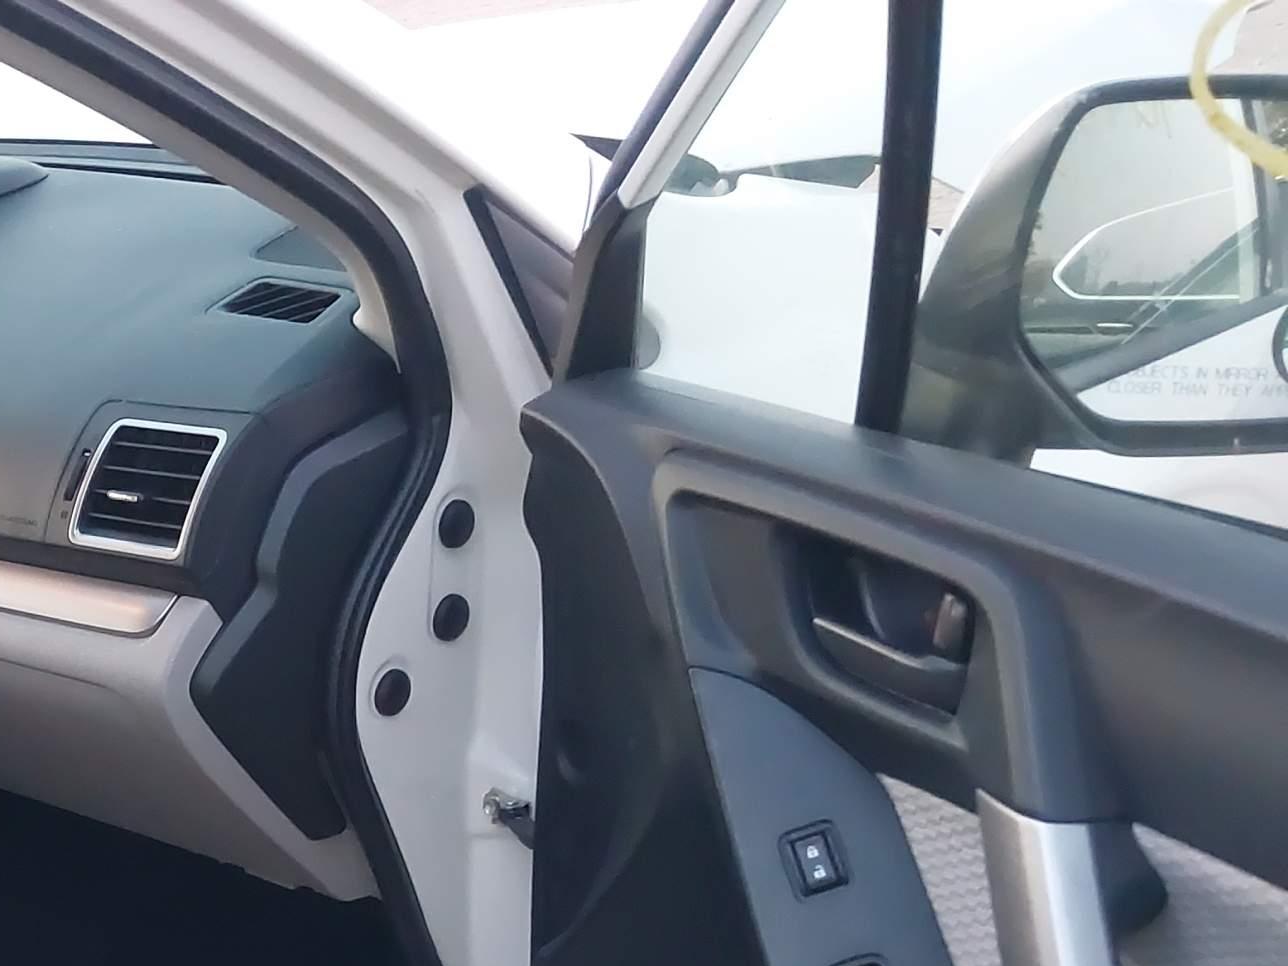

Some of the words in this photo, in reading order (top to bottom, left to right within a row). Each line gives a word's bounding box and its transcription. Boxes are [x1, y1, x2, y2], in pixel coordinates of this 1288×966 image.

[1194, 367, 1208, 380] IN
[1215, 367, 1268, 380] MIRROR
[1107, 380, 1161, 394] CLOSER
[1172, 381, 1208, 396] THAN
[1217, 383, 1253, 397] THEY
